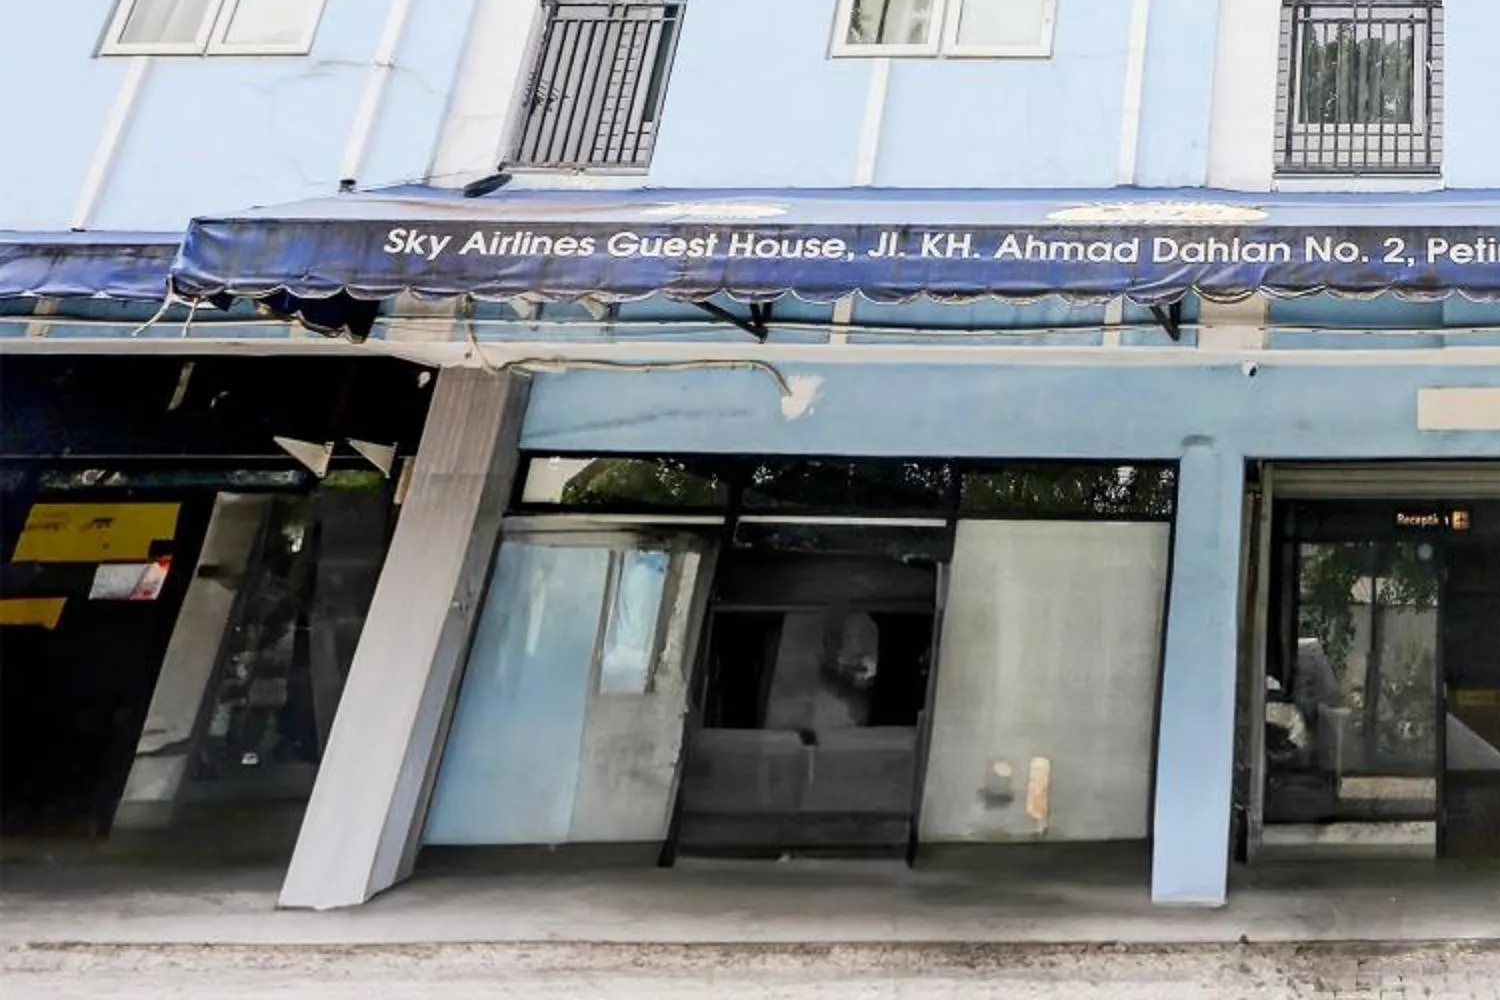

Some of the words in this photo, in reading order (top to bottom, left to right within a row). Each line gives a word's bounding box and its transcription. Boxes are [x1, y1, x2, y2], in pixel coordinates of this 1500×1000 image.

[383, 227, 451, 260] Sky
[458, 231, 596, 257] Airlines
[607, 231, 719, 258] Guest
[728, 232, 855, 262] House,
[920, 233, 980, 259] KH.
[993, 234, 1139, 262] Ahmad
[1152, 236, 1291, 263] Dahlan
[1305, 236, 1368, 263] No.
[1383, 237, 1415, 267] 2,
